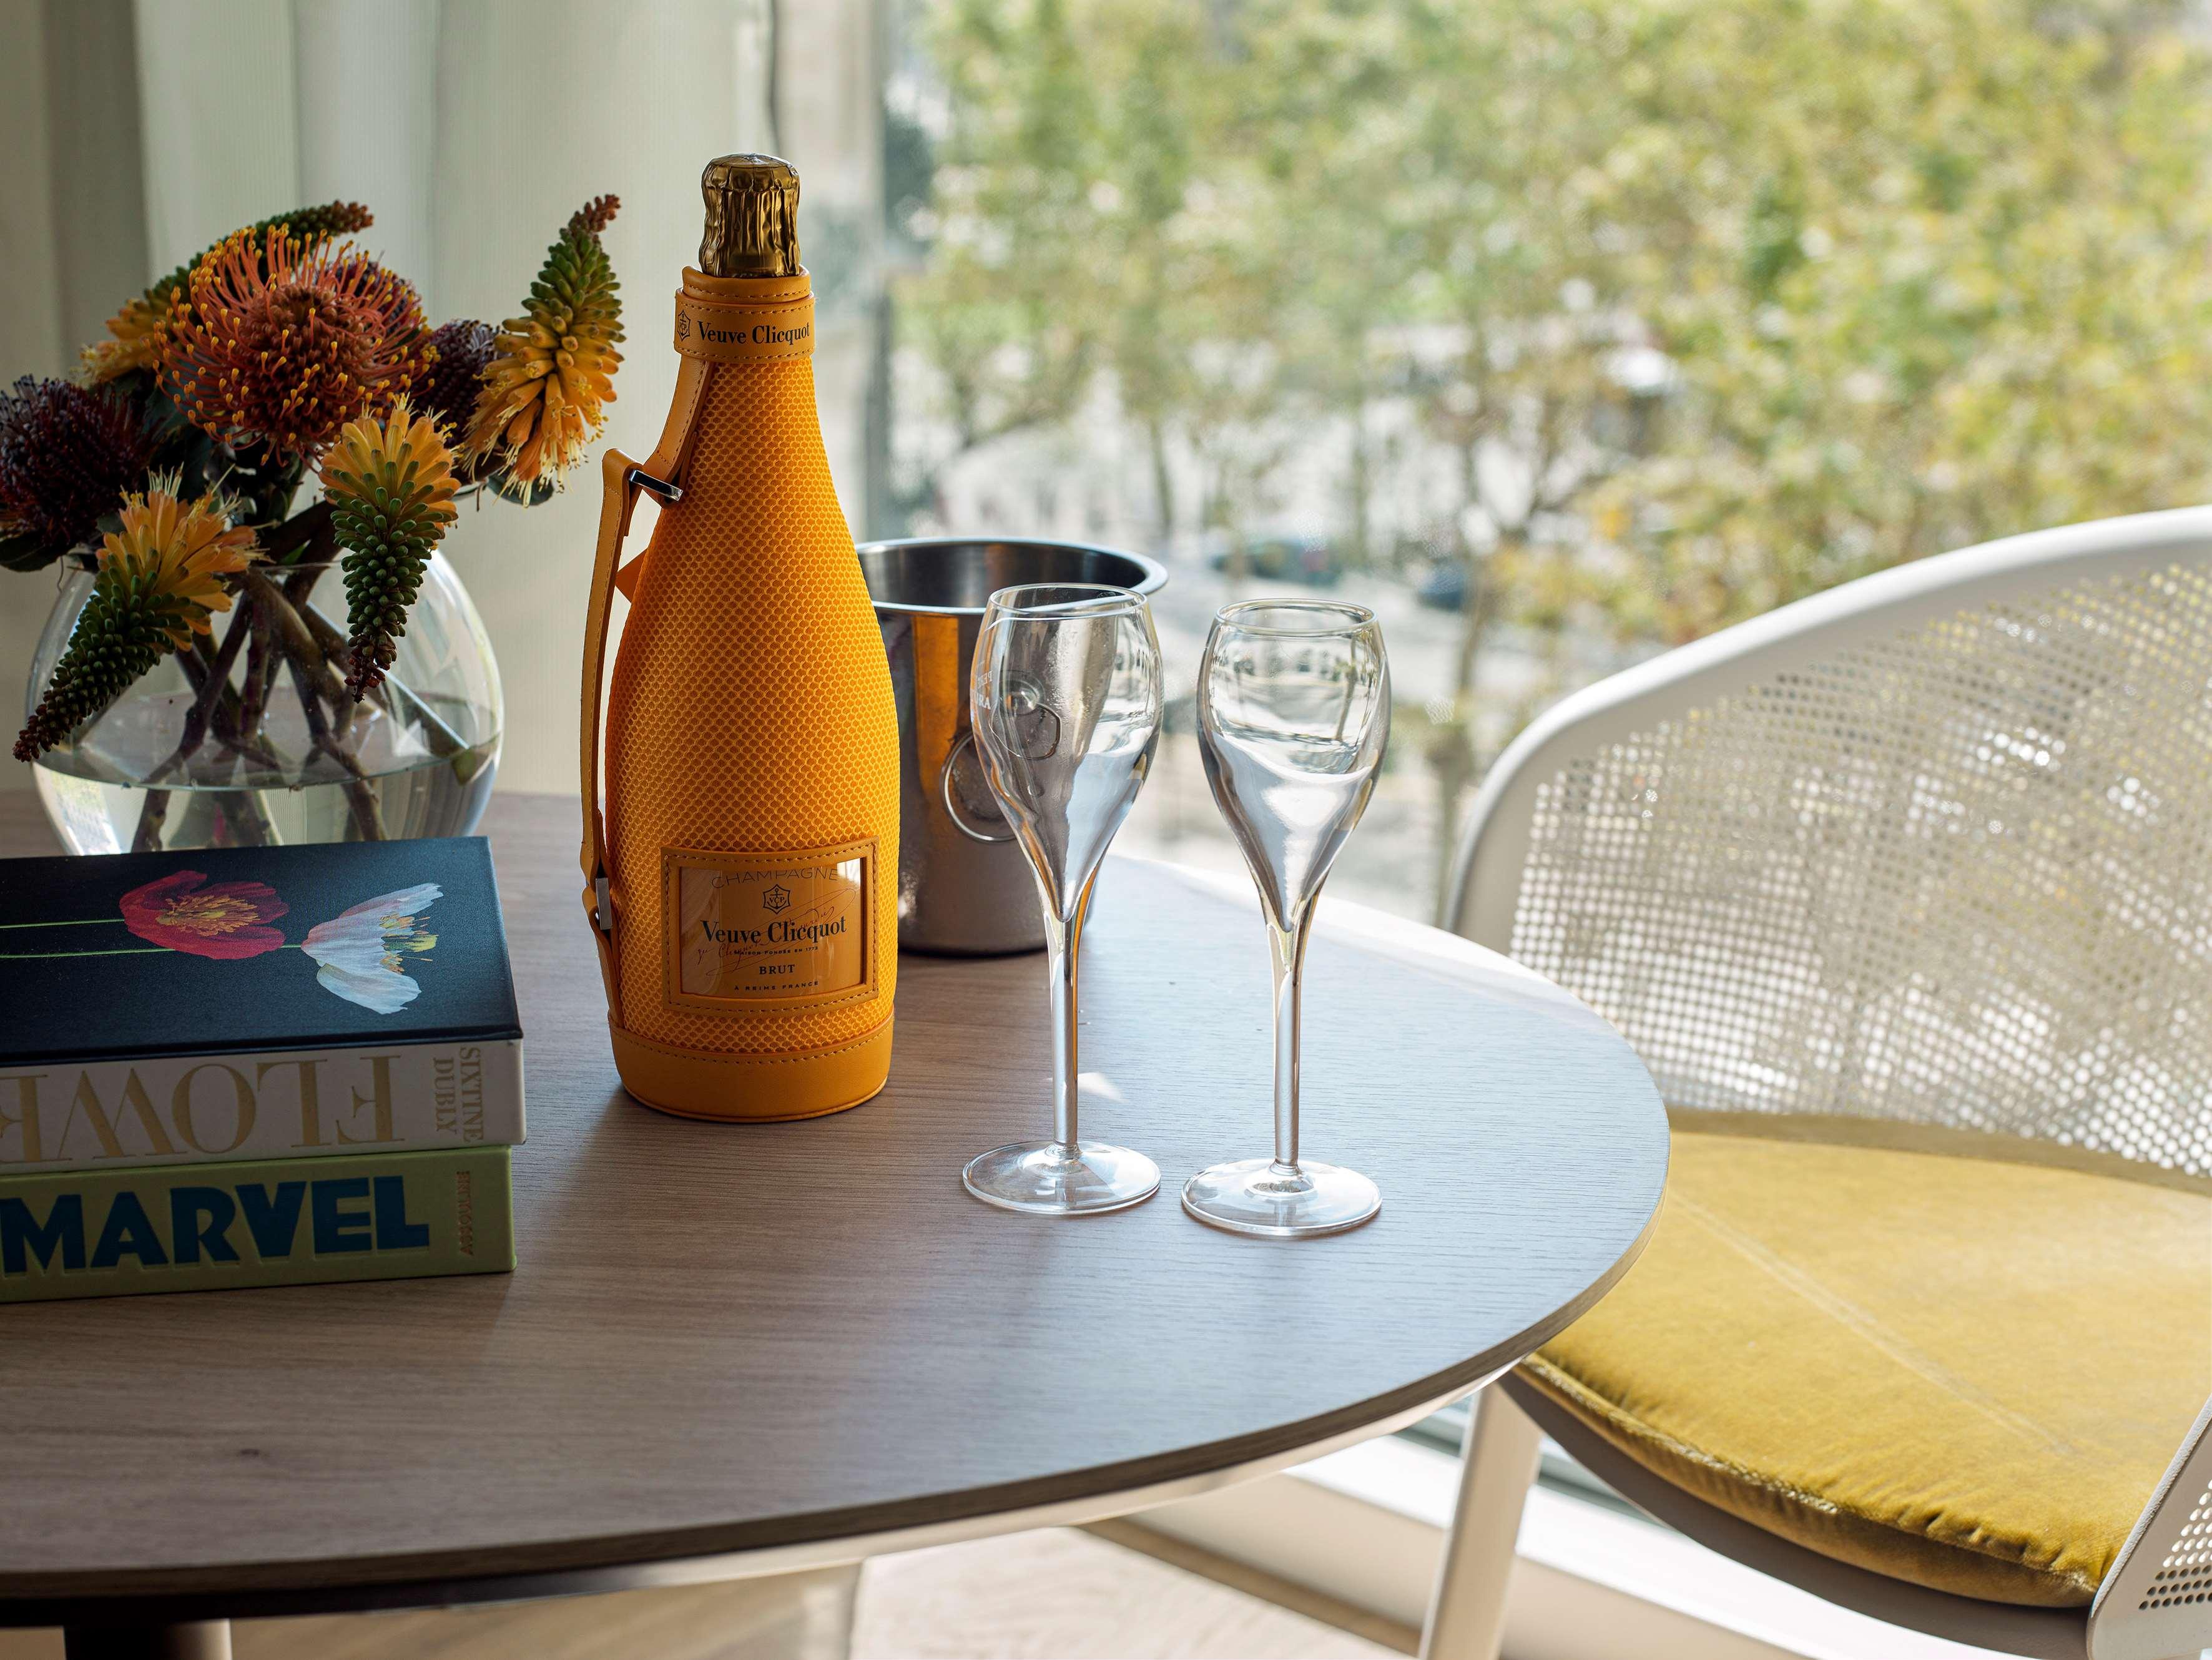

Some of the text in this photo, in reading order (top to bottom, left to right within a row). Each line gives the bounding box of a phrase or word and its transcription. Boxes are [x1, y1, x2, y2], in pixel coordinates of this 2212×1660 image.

[697, 321, 809, 345] Veuve Clicquot
[711, 867, 838, 888] CHAMPAGNE
[700, 920, 761, 943] Veuve
[767, 916, 847, 943] Clicquot
[759, 965, 795, 975] BRUT
[782, 981, 818, 990] FRANCE
[433, 1058, 457, 1134] DUBLY
[460, 1047, 483, 1142] SIXTINE
[0, 1176, 430, 1274] MARVEL
